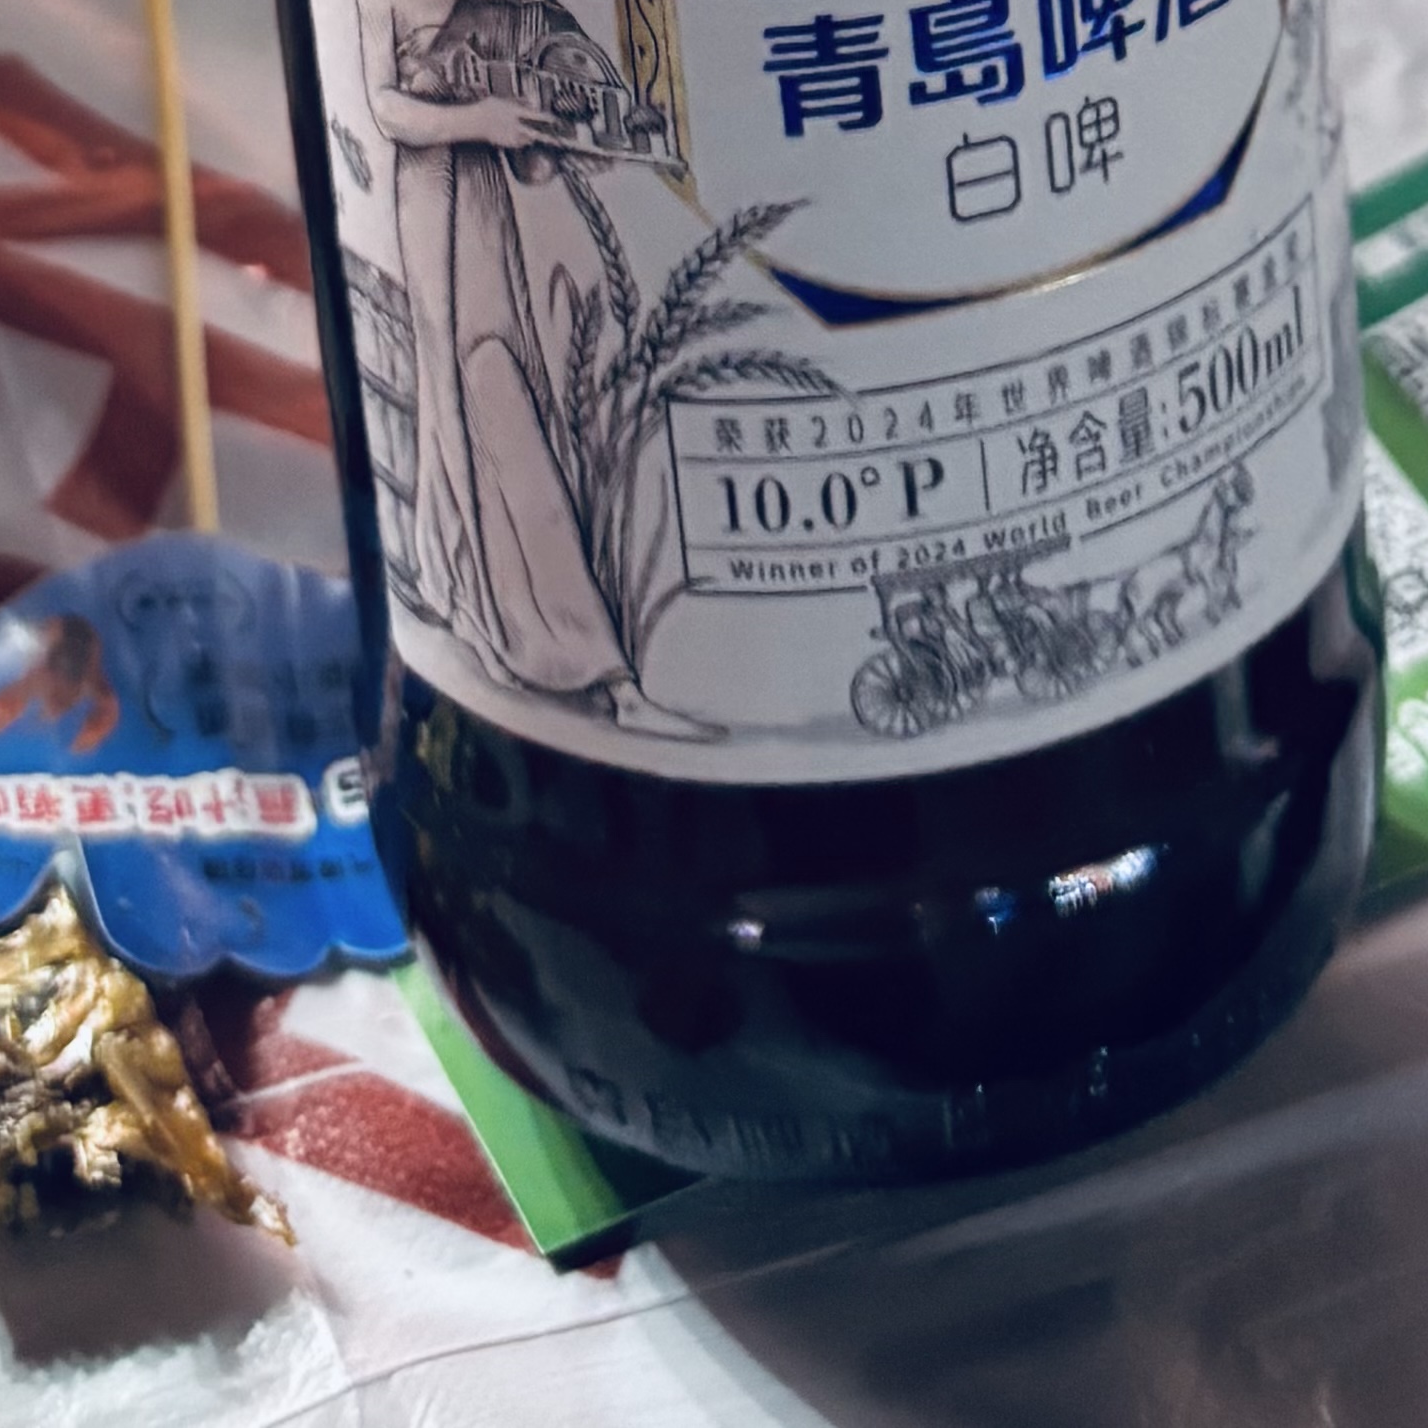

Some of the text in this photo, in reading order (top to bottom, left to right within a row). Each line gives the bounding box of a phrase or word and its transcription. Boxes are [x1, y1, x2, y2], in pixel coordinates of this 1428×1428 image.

[946, 95, 1123, 223] 白啤
[729, 558, 836, 583] Winner
[850, 548, 880, 575] of
[897, 537, 967, 571] 2024
[982, 512, 1068, 551] World
[1085, 482, 1143, 521] Beer
